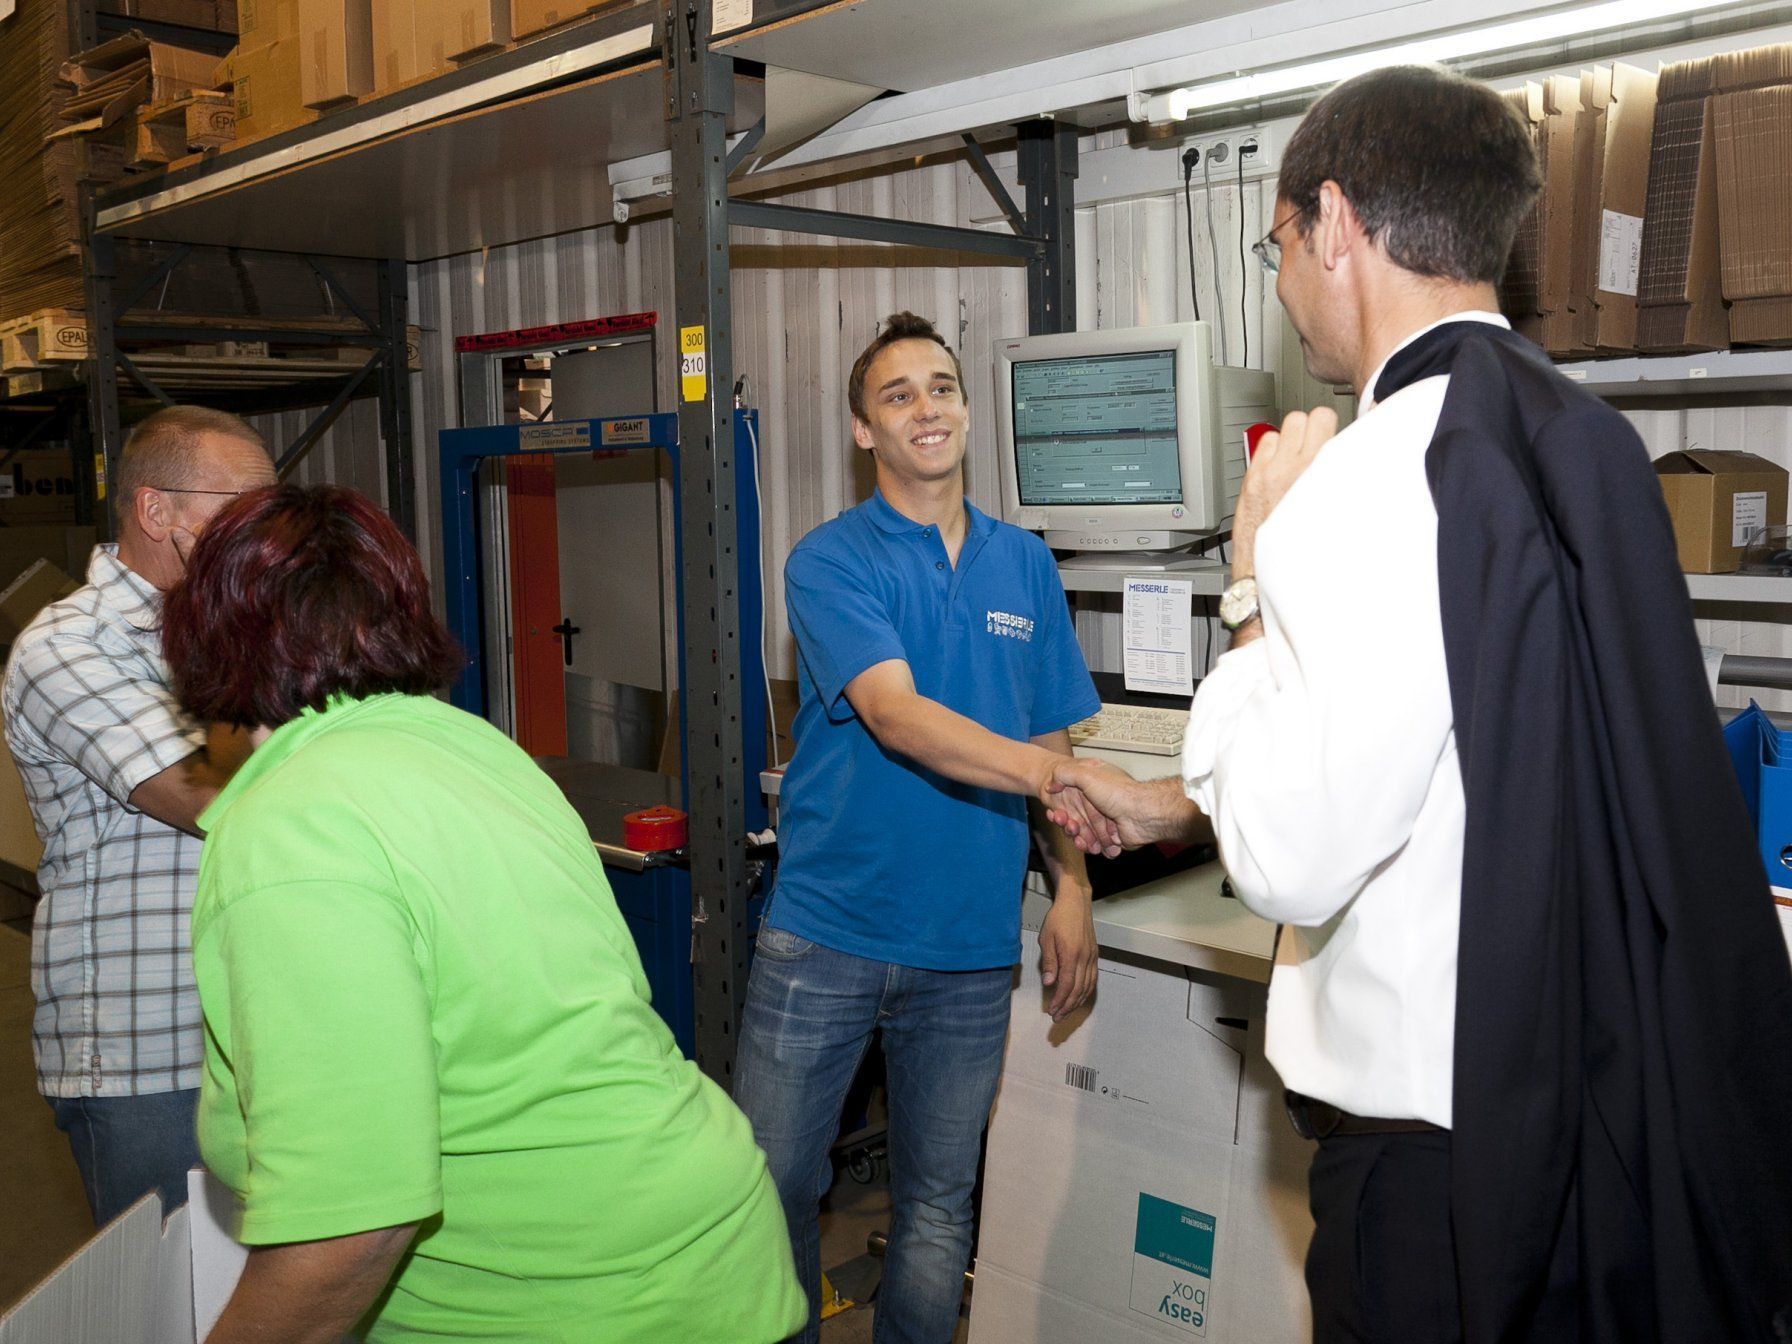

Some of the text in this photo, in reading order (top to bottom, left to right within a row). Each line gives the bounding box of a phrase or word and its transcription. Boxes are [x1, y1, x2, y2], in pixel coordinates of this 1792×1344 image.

[216, 115, 236, 129] EPA
[62, 331, 88, 343] EPAL
[686, 332, 703, 347] 300
[683, 357, 704, 374] 310
[613, 421, 643, 433] GIGANT
[1128, 583, 1169, 594] MESSERLE
[987, 610, 1034, 632] MESSERLE
[1172, 1280, 1206, 1312] box
[1158, 1295, 1204, 1328] easy
